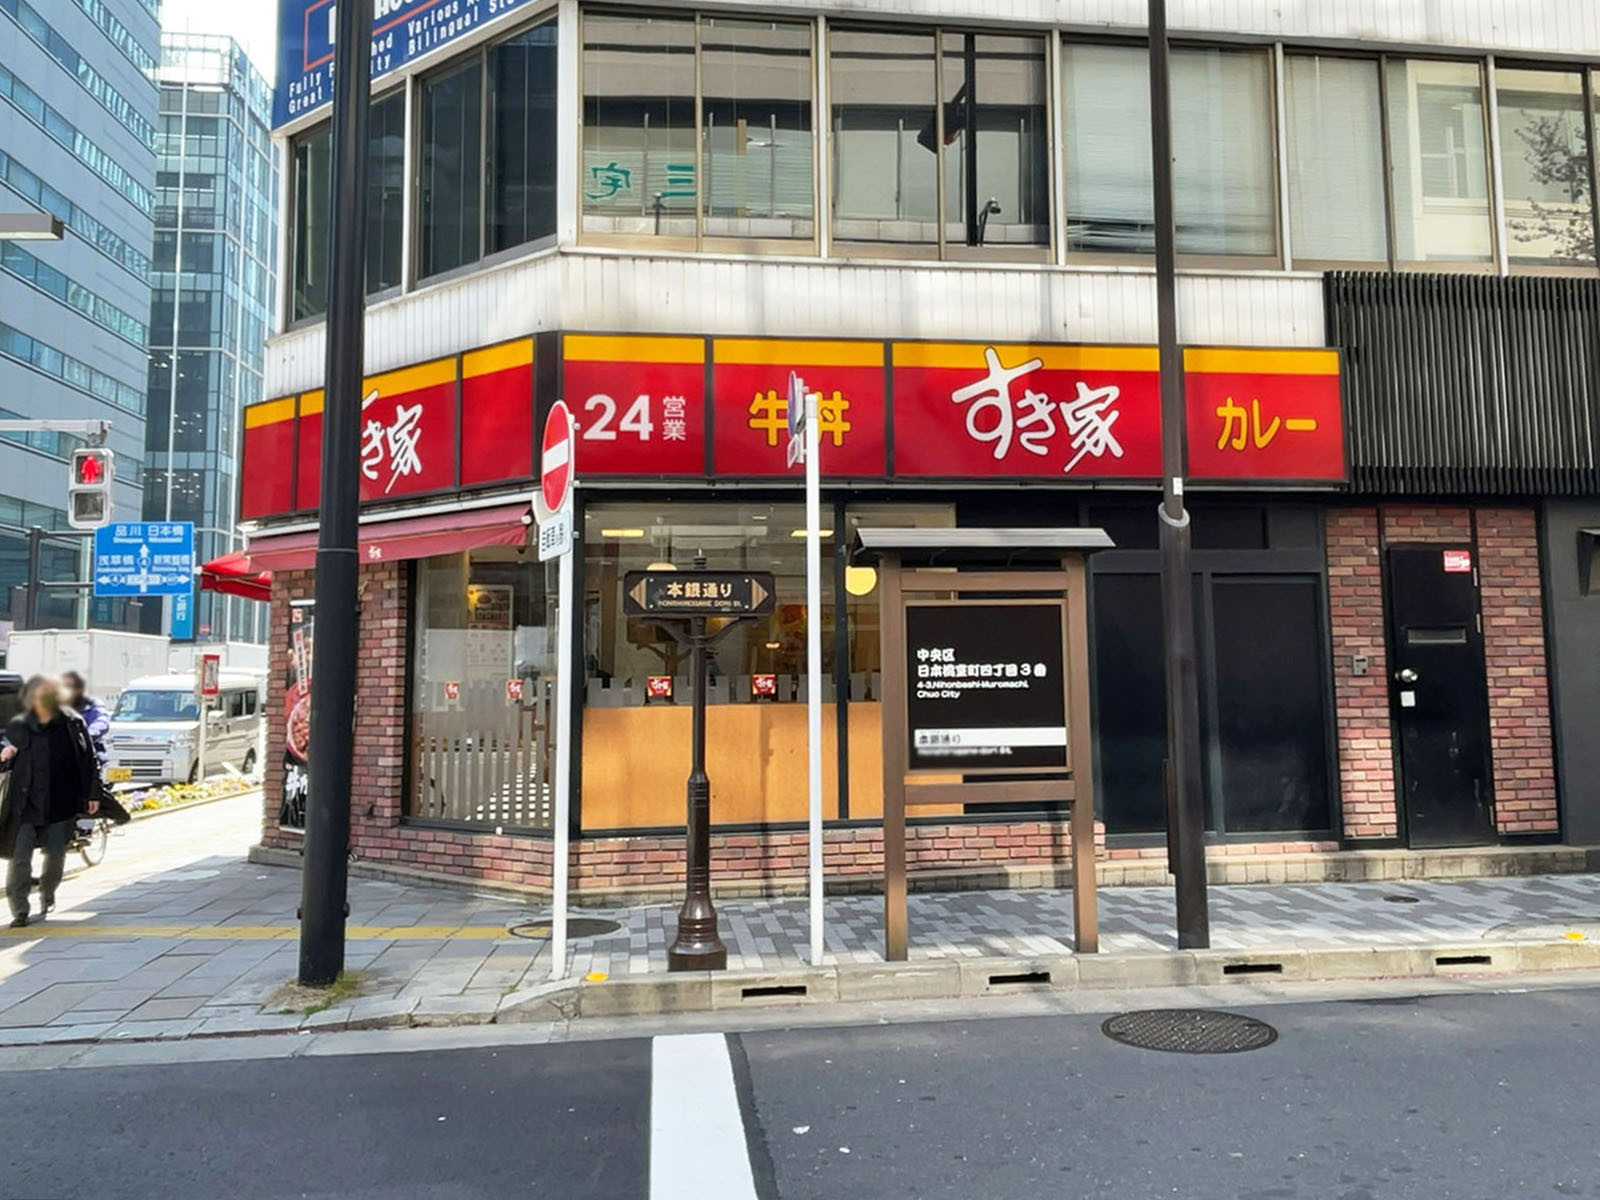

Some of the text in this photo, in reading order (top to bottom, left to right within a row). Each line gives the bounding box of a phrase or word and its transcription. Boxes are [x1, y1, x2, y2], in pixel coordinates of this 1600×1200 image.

[408, 2, 459, 37] Various
[408, 6, 479, 55] Bilingual
[289, 72, 321, 98] Fully
[288, 90, 322, 114] Great
[583, 394, 686, 441] 24 営業
[951, 346, 1124, 473] すき家
[1216, 397, 1317, 450] カレー
[362, 390, 423, 494] き家
[115, 525, 184, 536] 品川 日本橋
[667, 582, 732, 598] 本銀通り
[917, 648, 955, 662] 中央区
[917, 690, 960, 699] Chuo City
